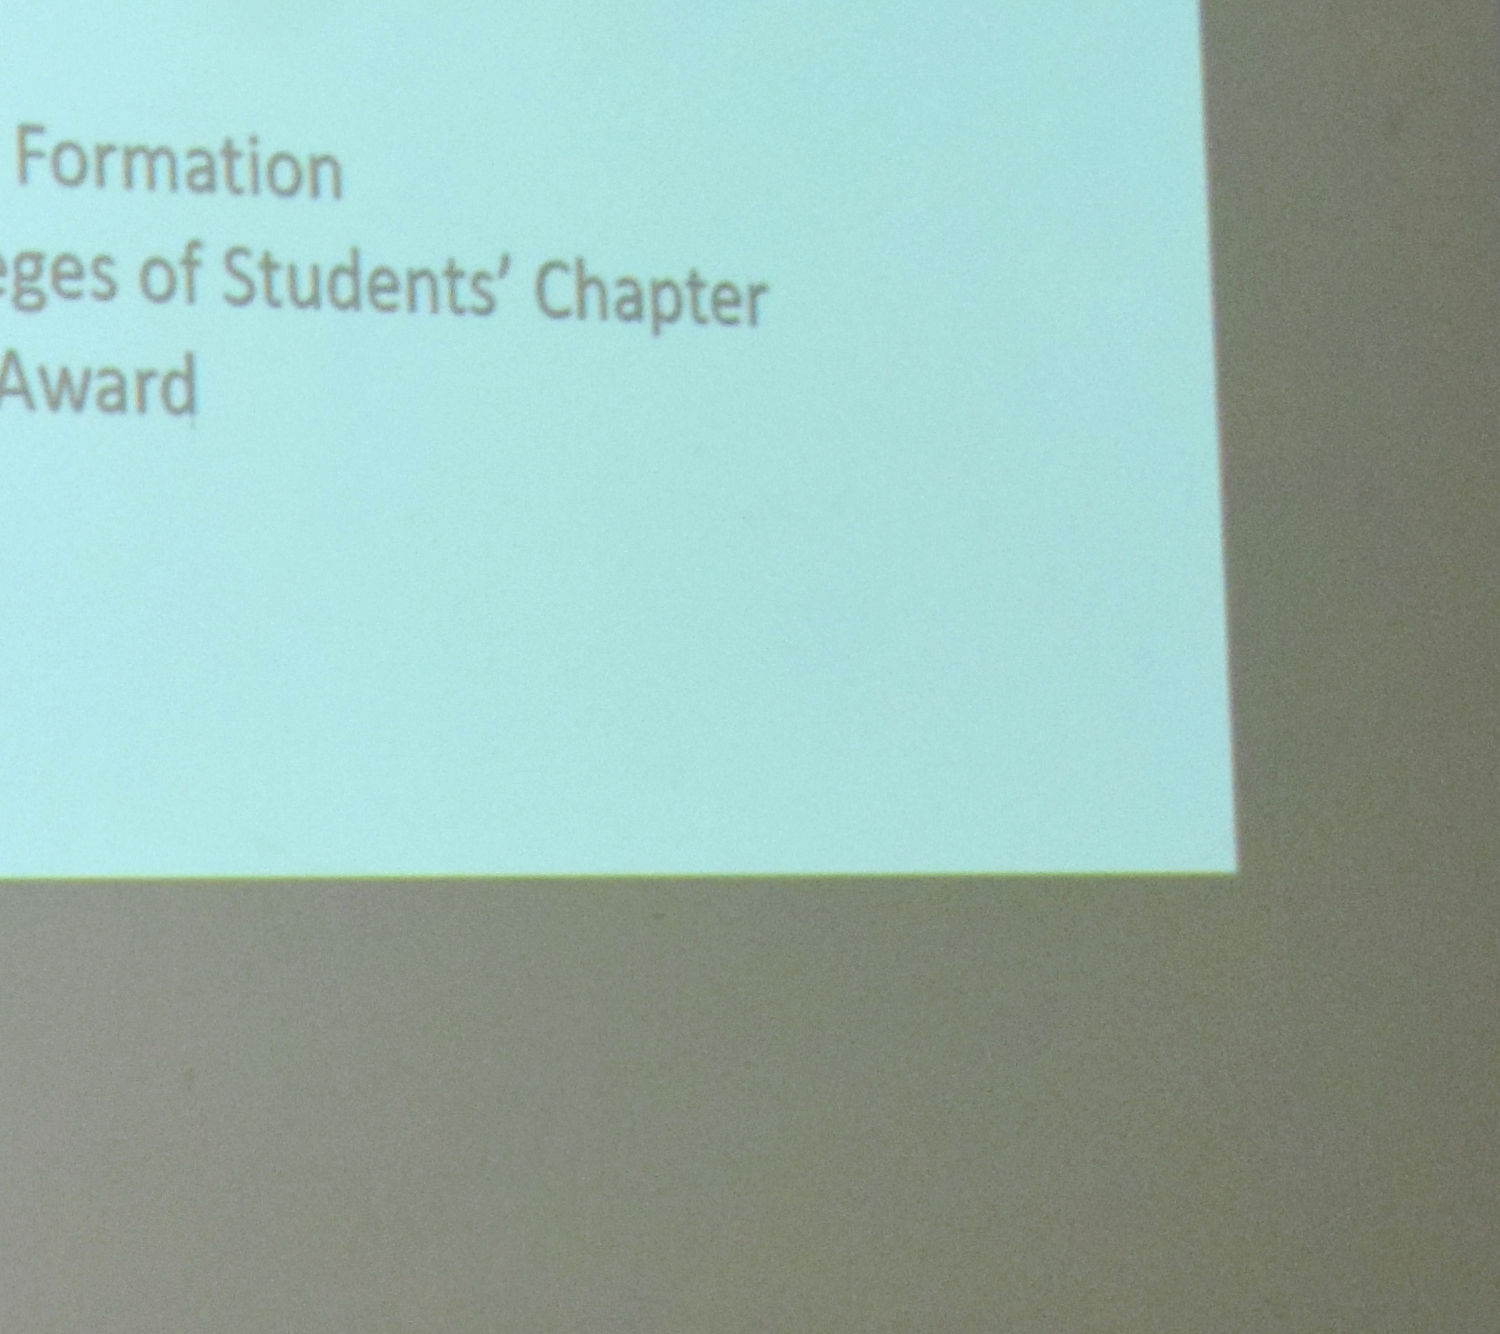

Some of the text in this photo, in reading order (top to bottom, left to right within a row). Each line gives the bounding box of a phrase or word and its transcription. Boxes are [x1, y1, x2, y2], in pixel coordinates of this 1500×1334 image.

[14, 124, 345, 204] Formation
[138, 239, 201, 309] of
[221, 243, 510, 320] Students’
[533, 257, 769, 333] Chapter
